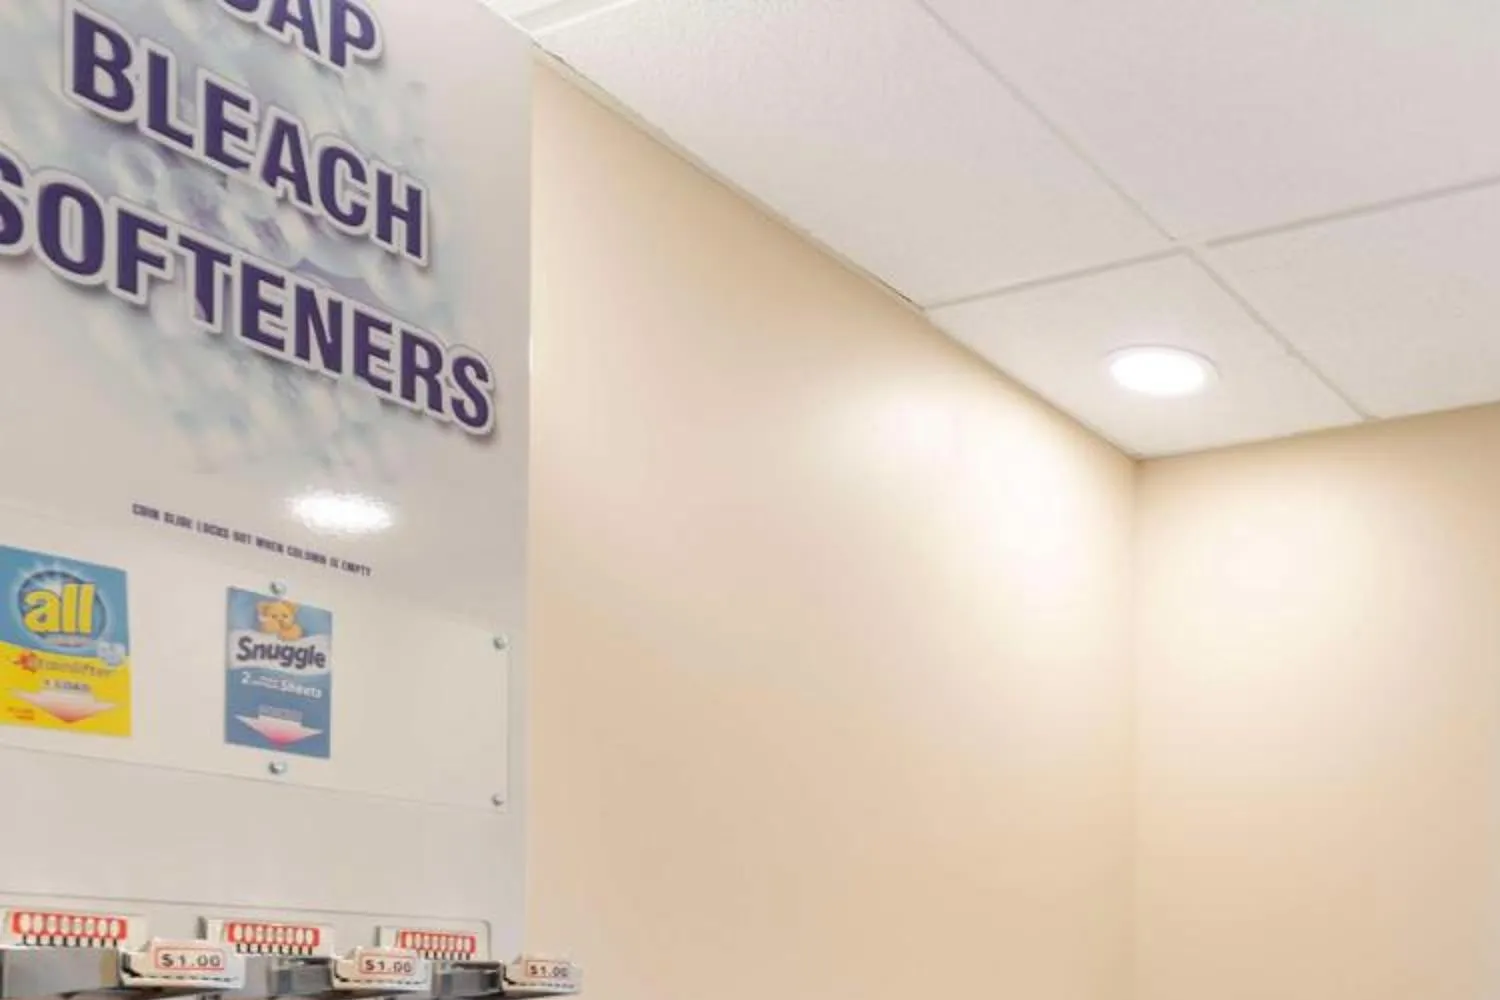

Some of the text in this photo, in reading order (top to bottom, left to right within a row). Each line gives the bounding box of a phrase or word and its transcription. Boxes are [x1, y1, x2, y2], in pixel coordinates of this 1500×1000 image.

[222, 0, 378, 68] AP
[70, 7, 426, 263] BLEACH
[23, 583, 95, 634] all
[236, 636, 327, 669] Snuggle
[160, 952, 222, 969] $1.00
[364, 958, 413, 973] $1.00
